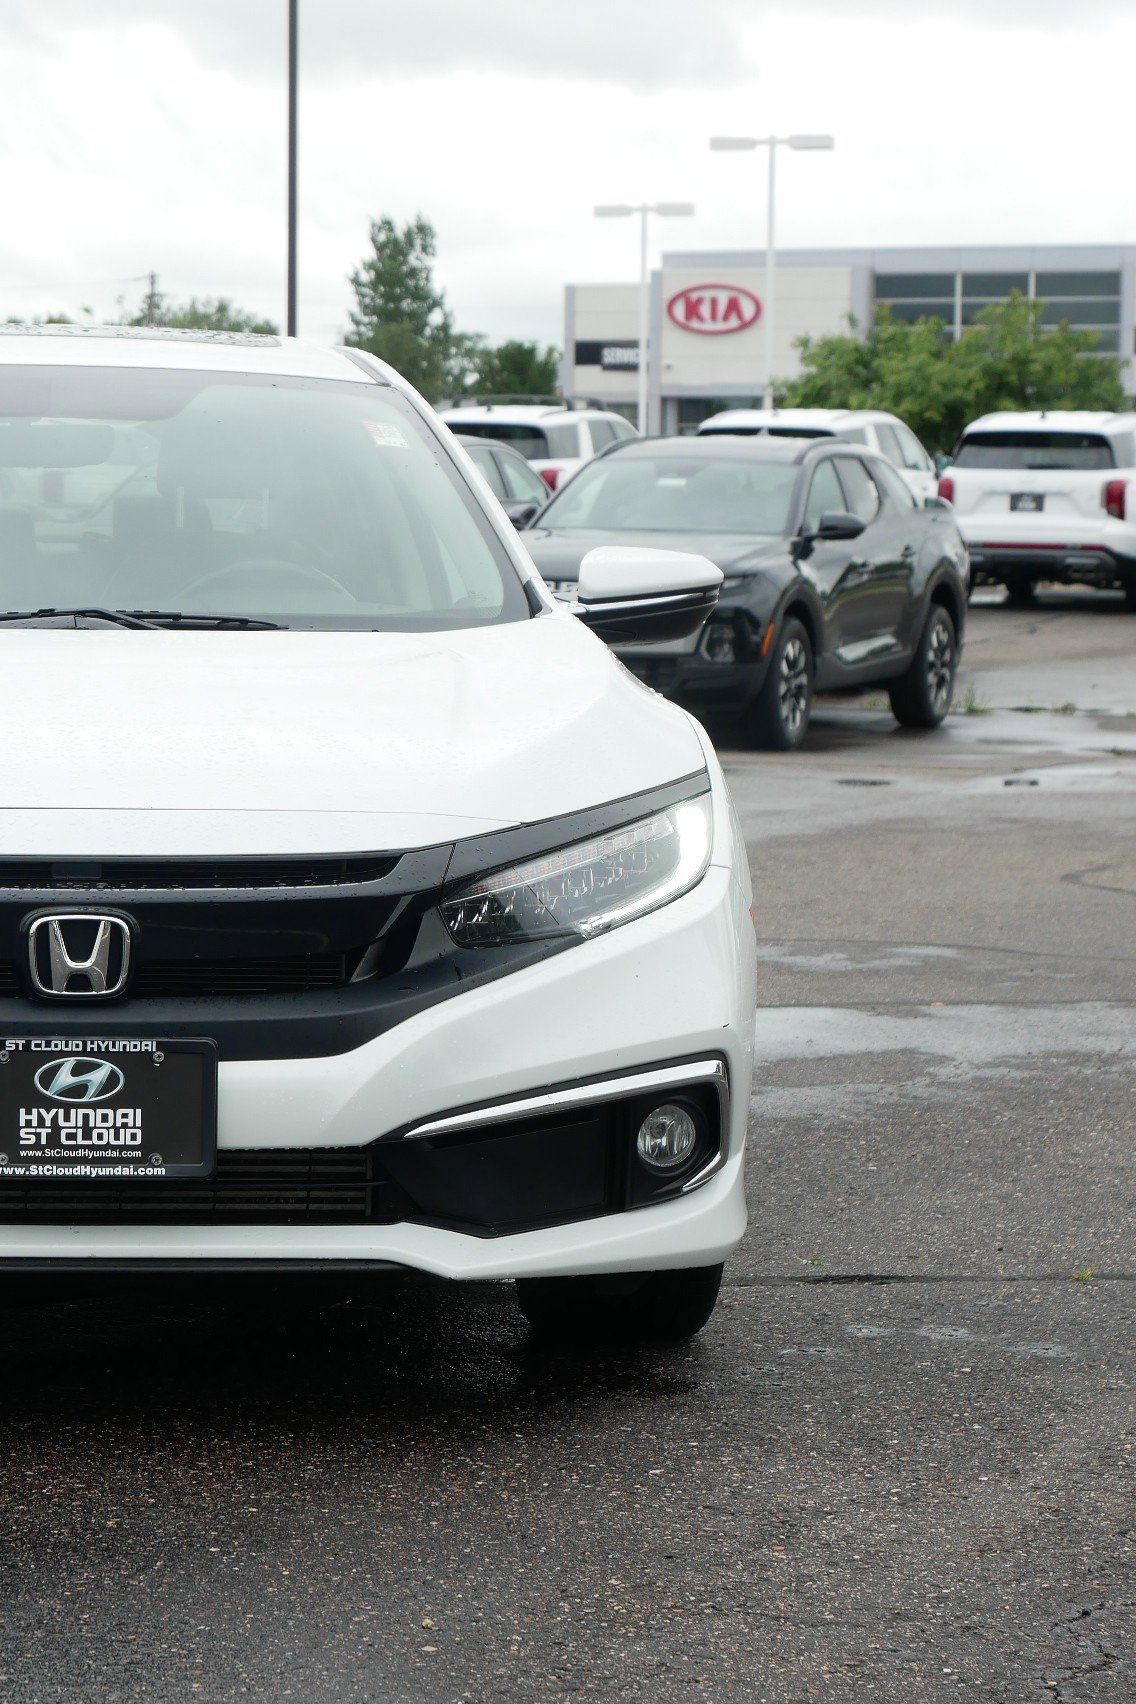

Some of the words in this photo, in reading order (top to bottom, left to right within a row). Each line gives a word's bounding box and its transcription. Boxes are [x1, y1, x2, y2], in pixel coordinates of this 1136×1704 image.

[684, 296, 746, 323] KIA
[5, 1040, 25, 1051] ST
[30, 1040, 83, 1052] CLOUD
[86, 1040, 157, 1052] HYUNDAI
[19, 1108, 142, 1128] HYUNDAI
[19, 1128, 51, 1145] ST
[60, 1128, 142, 1146] CLOUD
[19, 1148, 142, 1159] www.StCloudHyundai.com
